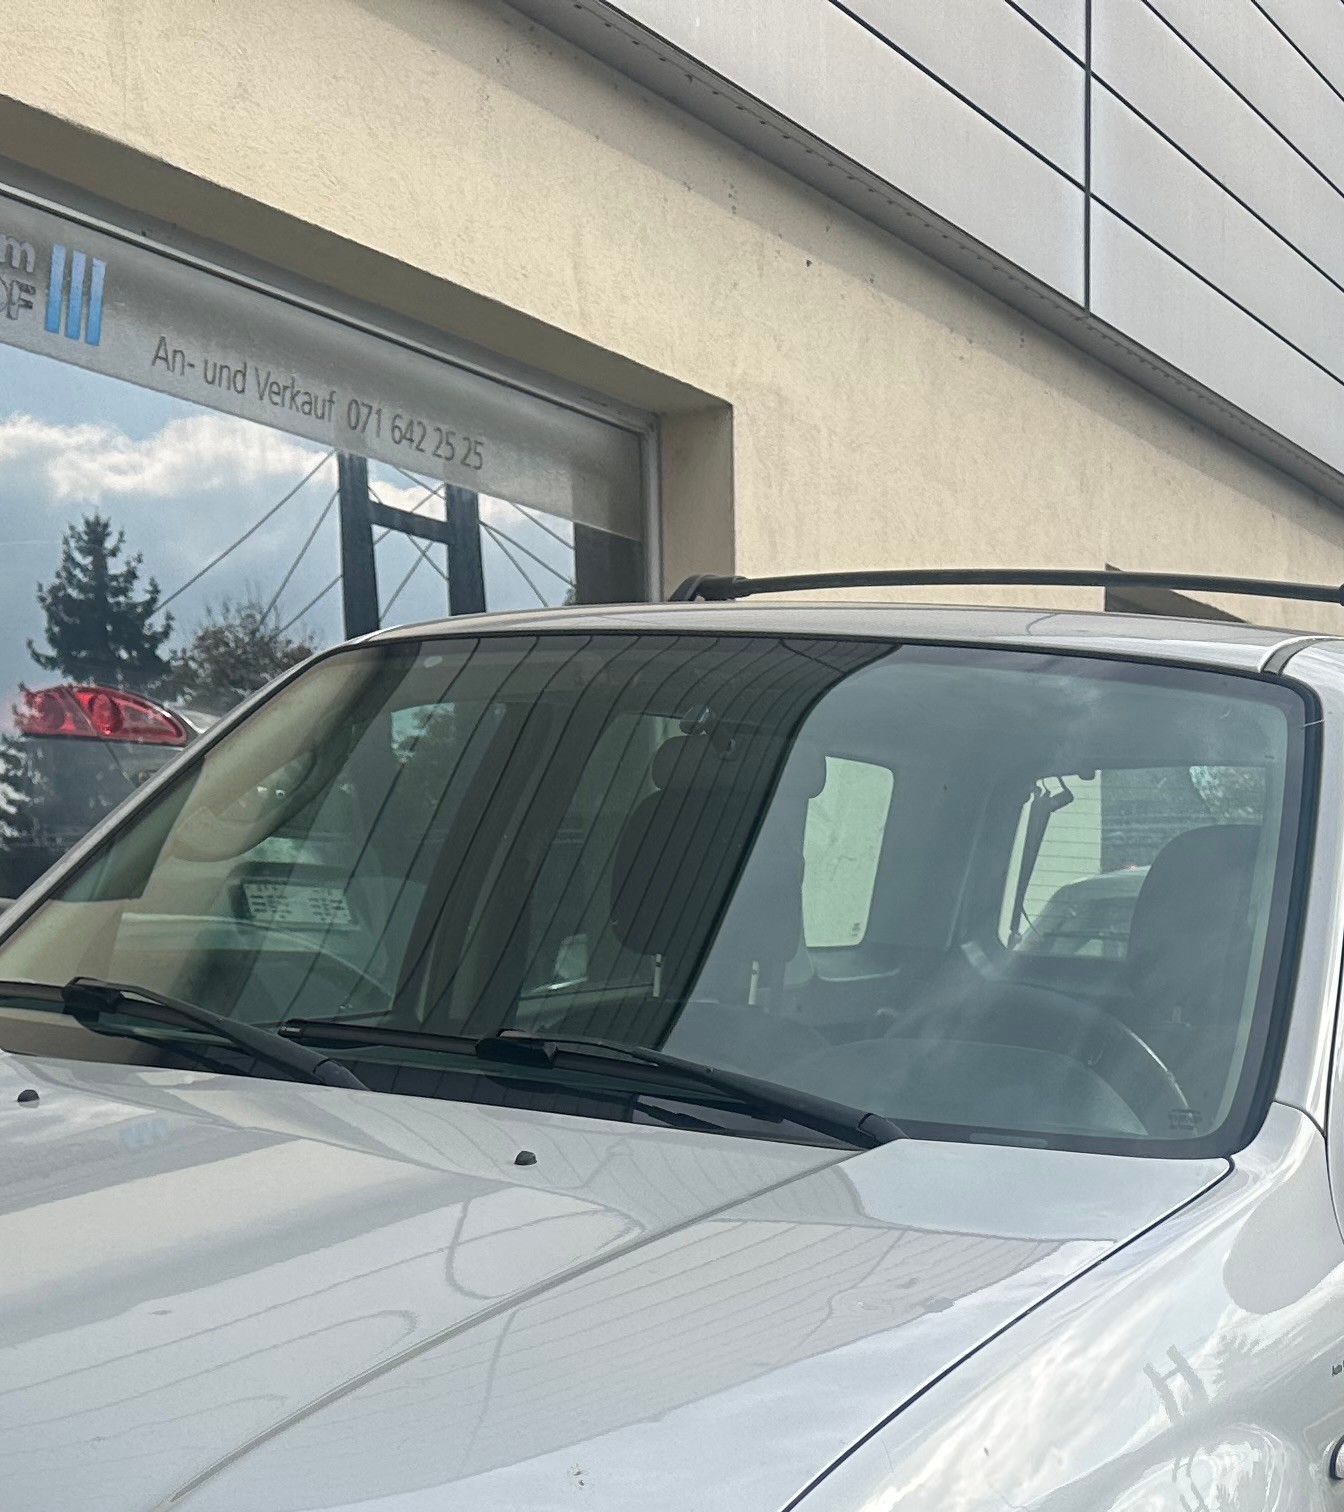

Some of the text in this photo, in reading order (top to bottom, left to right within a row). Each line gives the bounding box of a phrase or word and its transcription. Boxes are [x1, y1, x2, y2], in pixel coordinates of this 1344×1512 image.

[151, 335, 484, 470] An- und Verkauf 071 642 25 25
